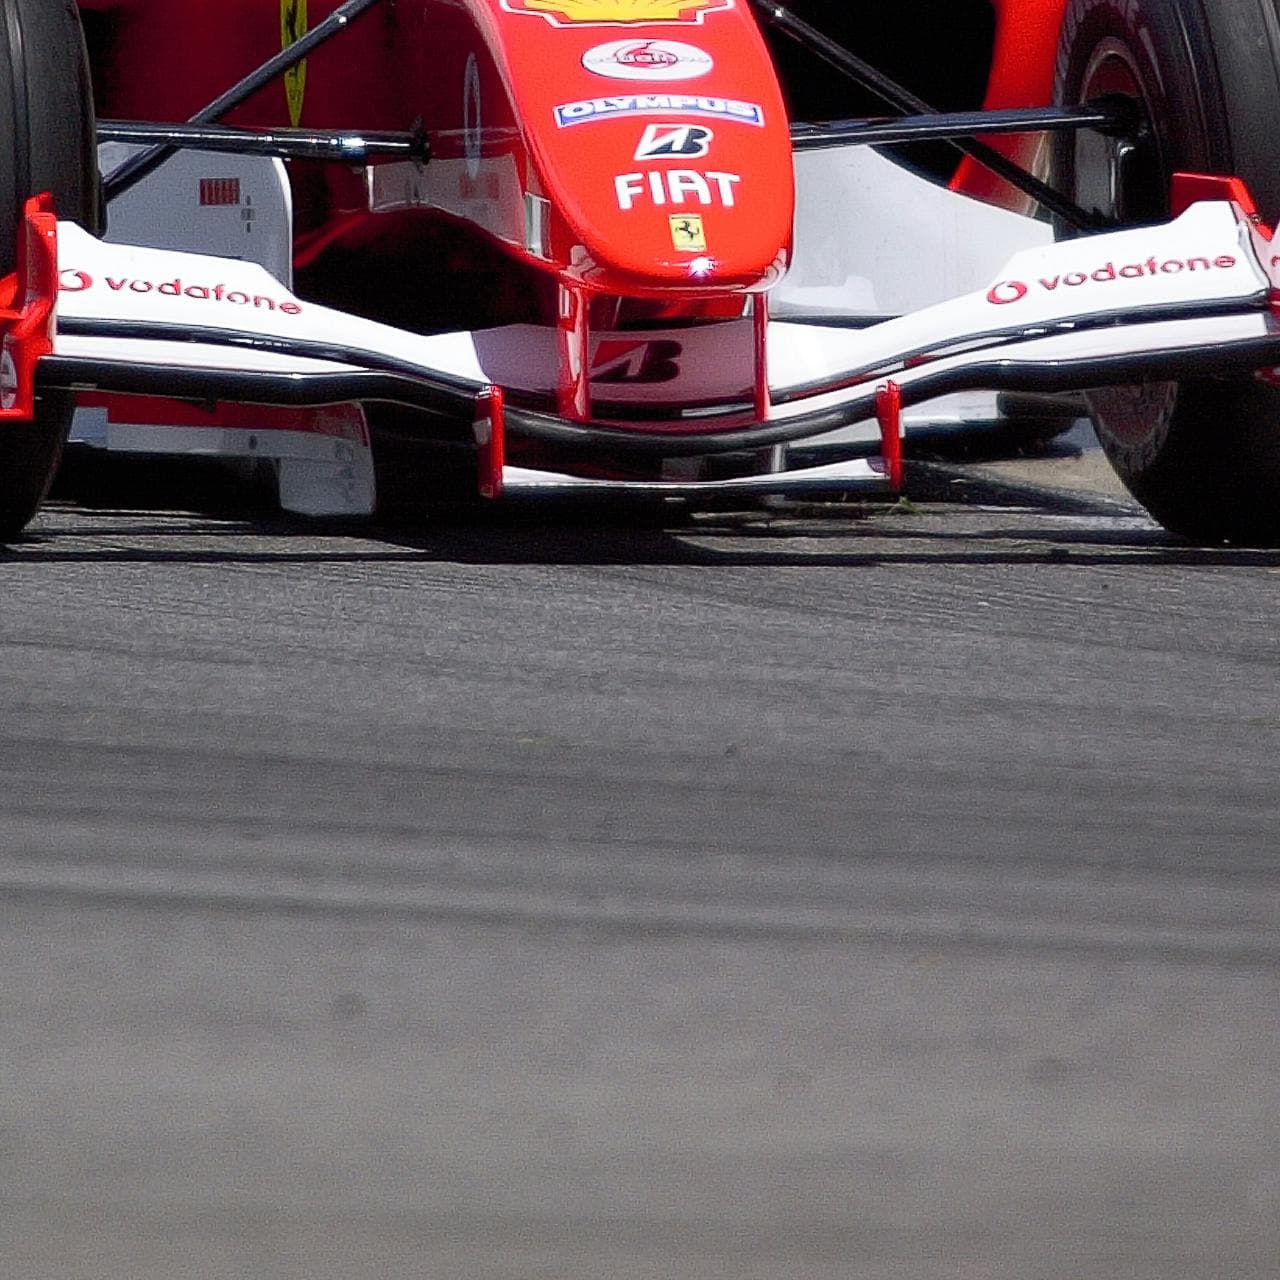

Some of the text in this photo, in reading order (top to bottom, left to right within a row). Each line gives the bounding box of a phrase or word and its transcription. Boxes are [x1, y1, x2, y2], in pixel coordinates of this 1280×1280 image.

[561, 96, 758, 118] OLYMPUS
[614, 170, 741, 210] FIAT
[1039, 255, 1236, 291] vodafone
[105, 277, 302, 315] vodafone
